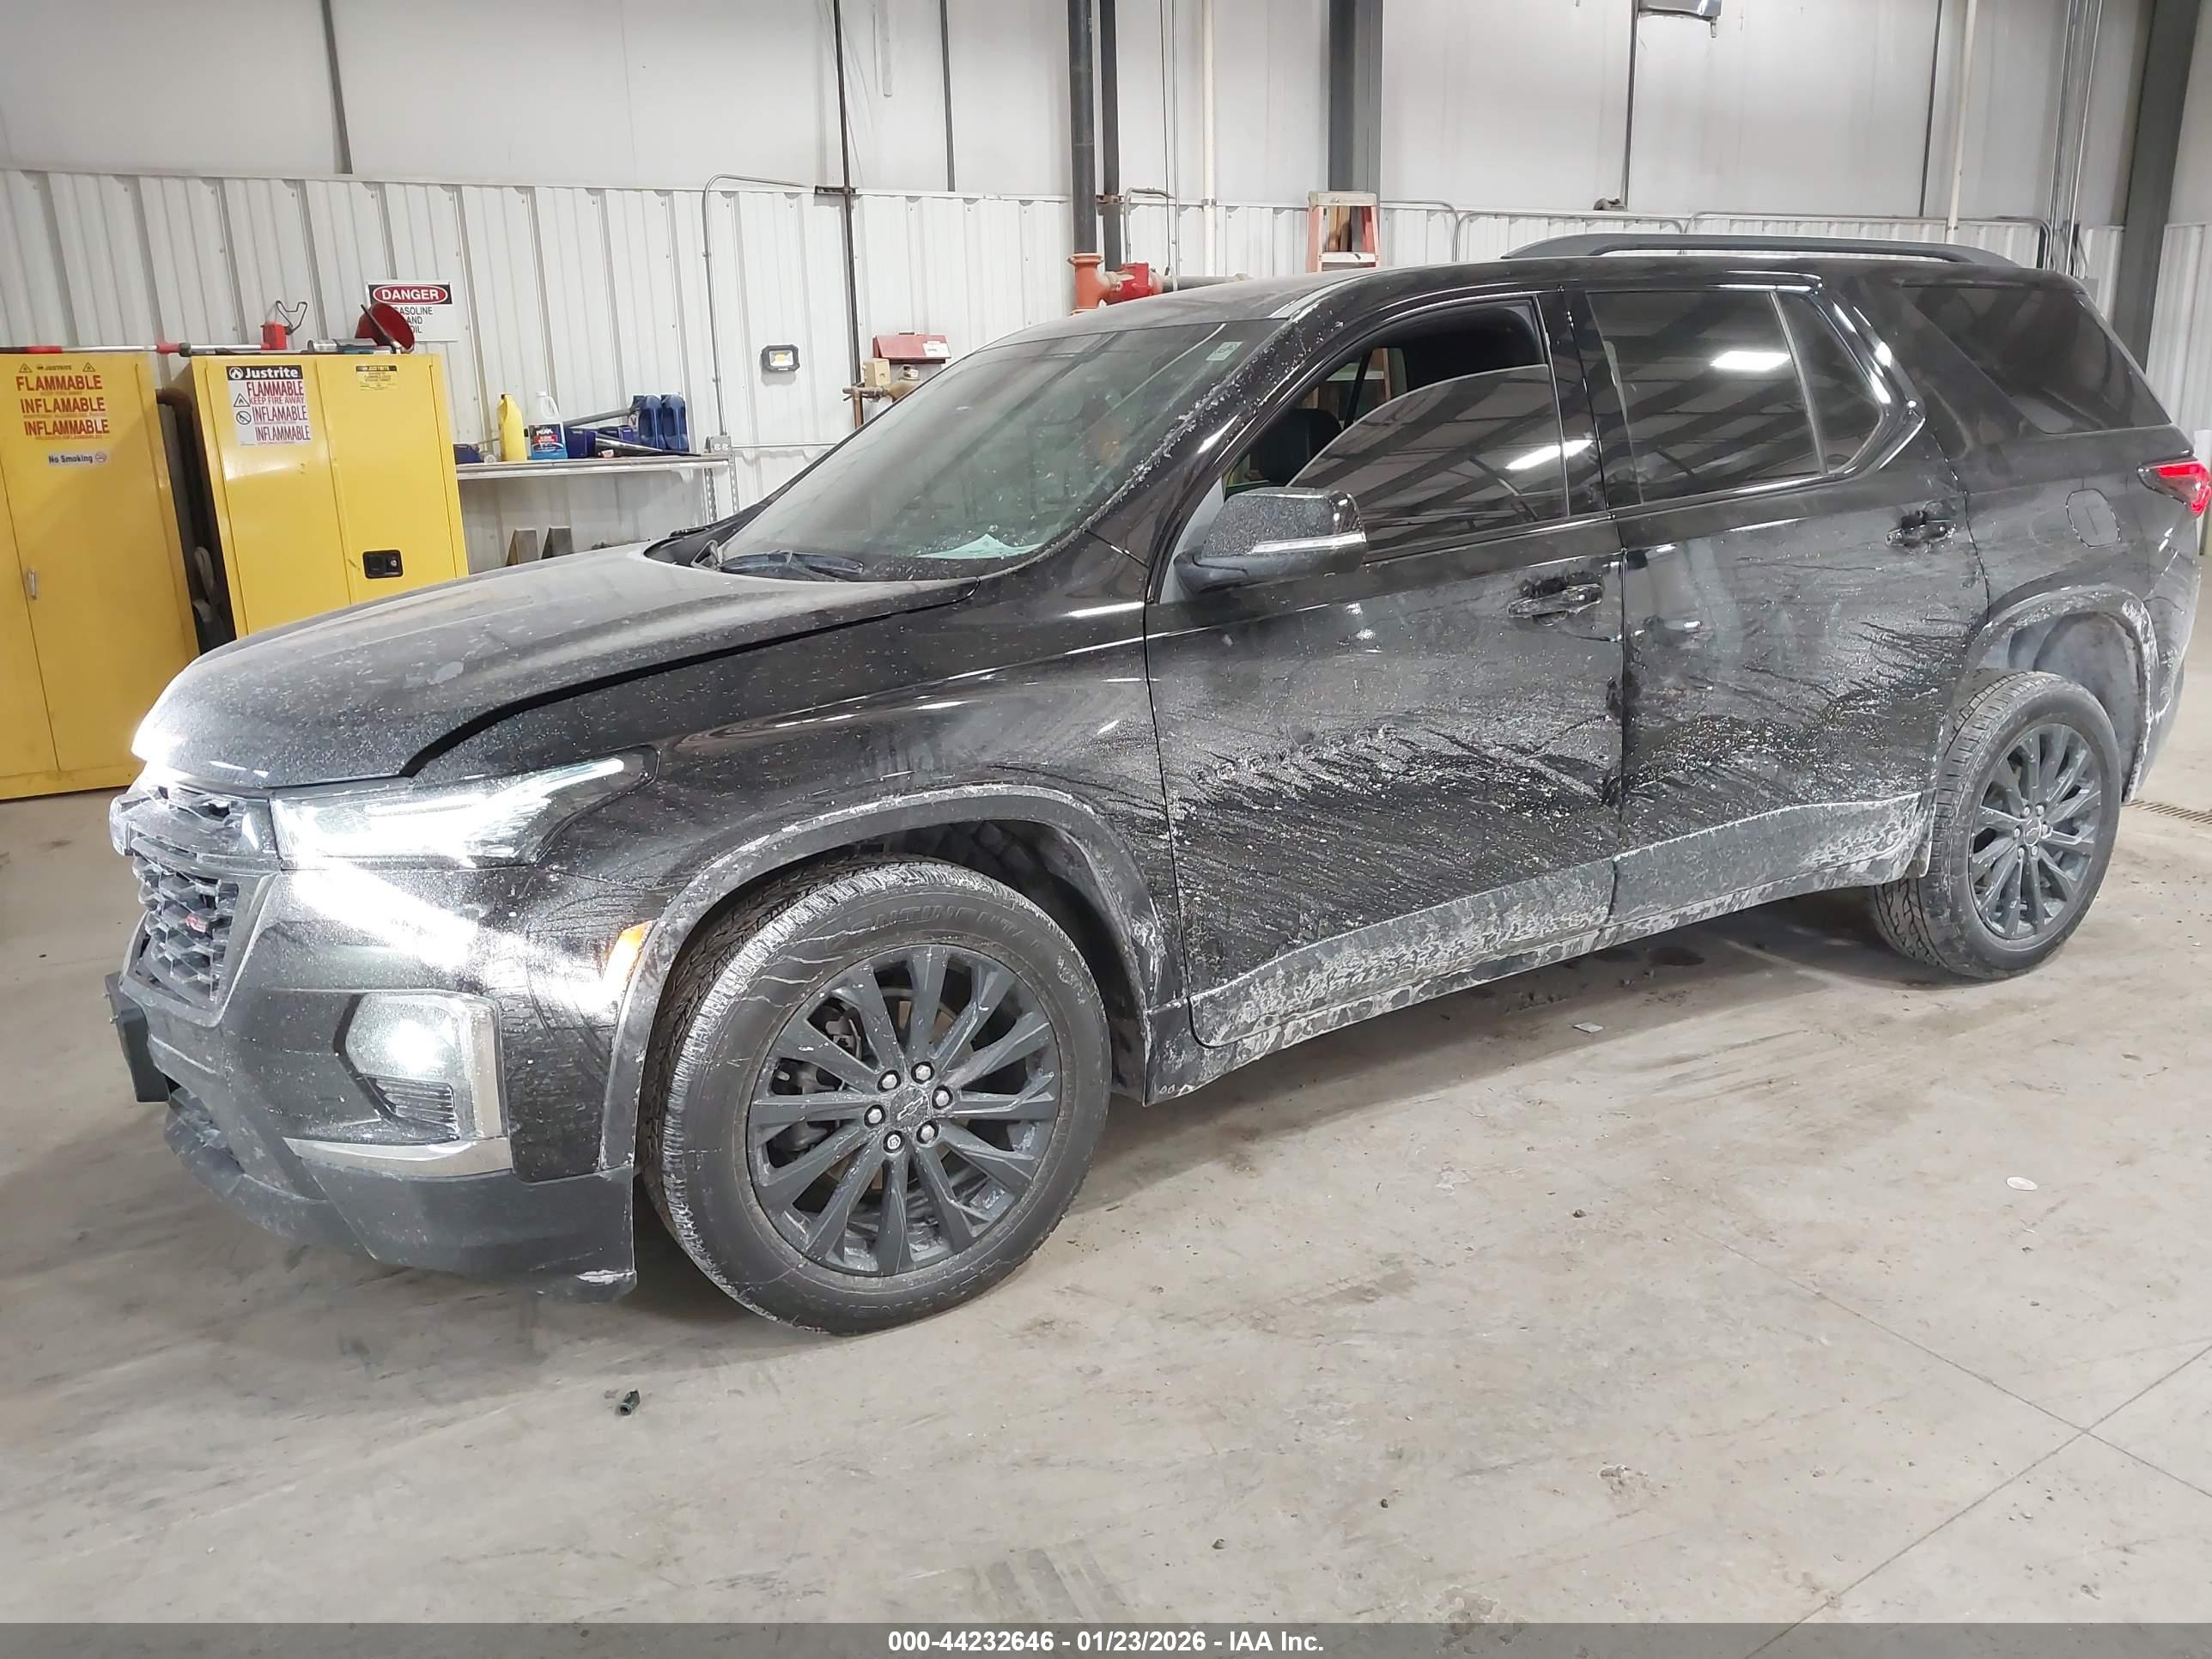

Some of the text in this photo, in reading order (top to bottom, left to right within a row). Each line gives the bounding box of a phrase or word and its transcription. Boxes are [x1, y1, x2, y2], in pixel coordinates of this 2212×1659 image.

[381, 289, 440, 300] DANGER
[245, 367, 299, 378] Justrite
[15, 375, 103, 391] FLAMMABLE
[246, 380, 305, 398] FLAMMABLE
[21, 397, 106, 413] INFLAMABLE
[249, 397, 267, 405] KEEP
[284, 396, 304, 404] AWAY
[252, 405, 308, 422] INFLAMABLE
[24, 419, 110, 436] INFLAMMABLE
[254, 426, 312, 441] INFLAMMABLE
[48, 454, 94, 465] No Smoking
